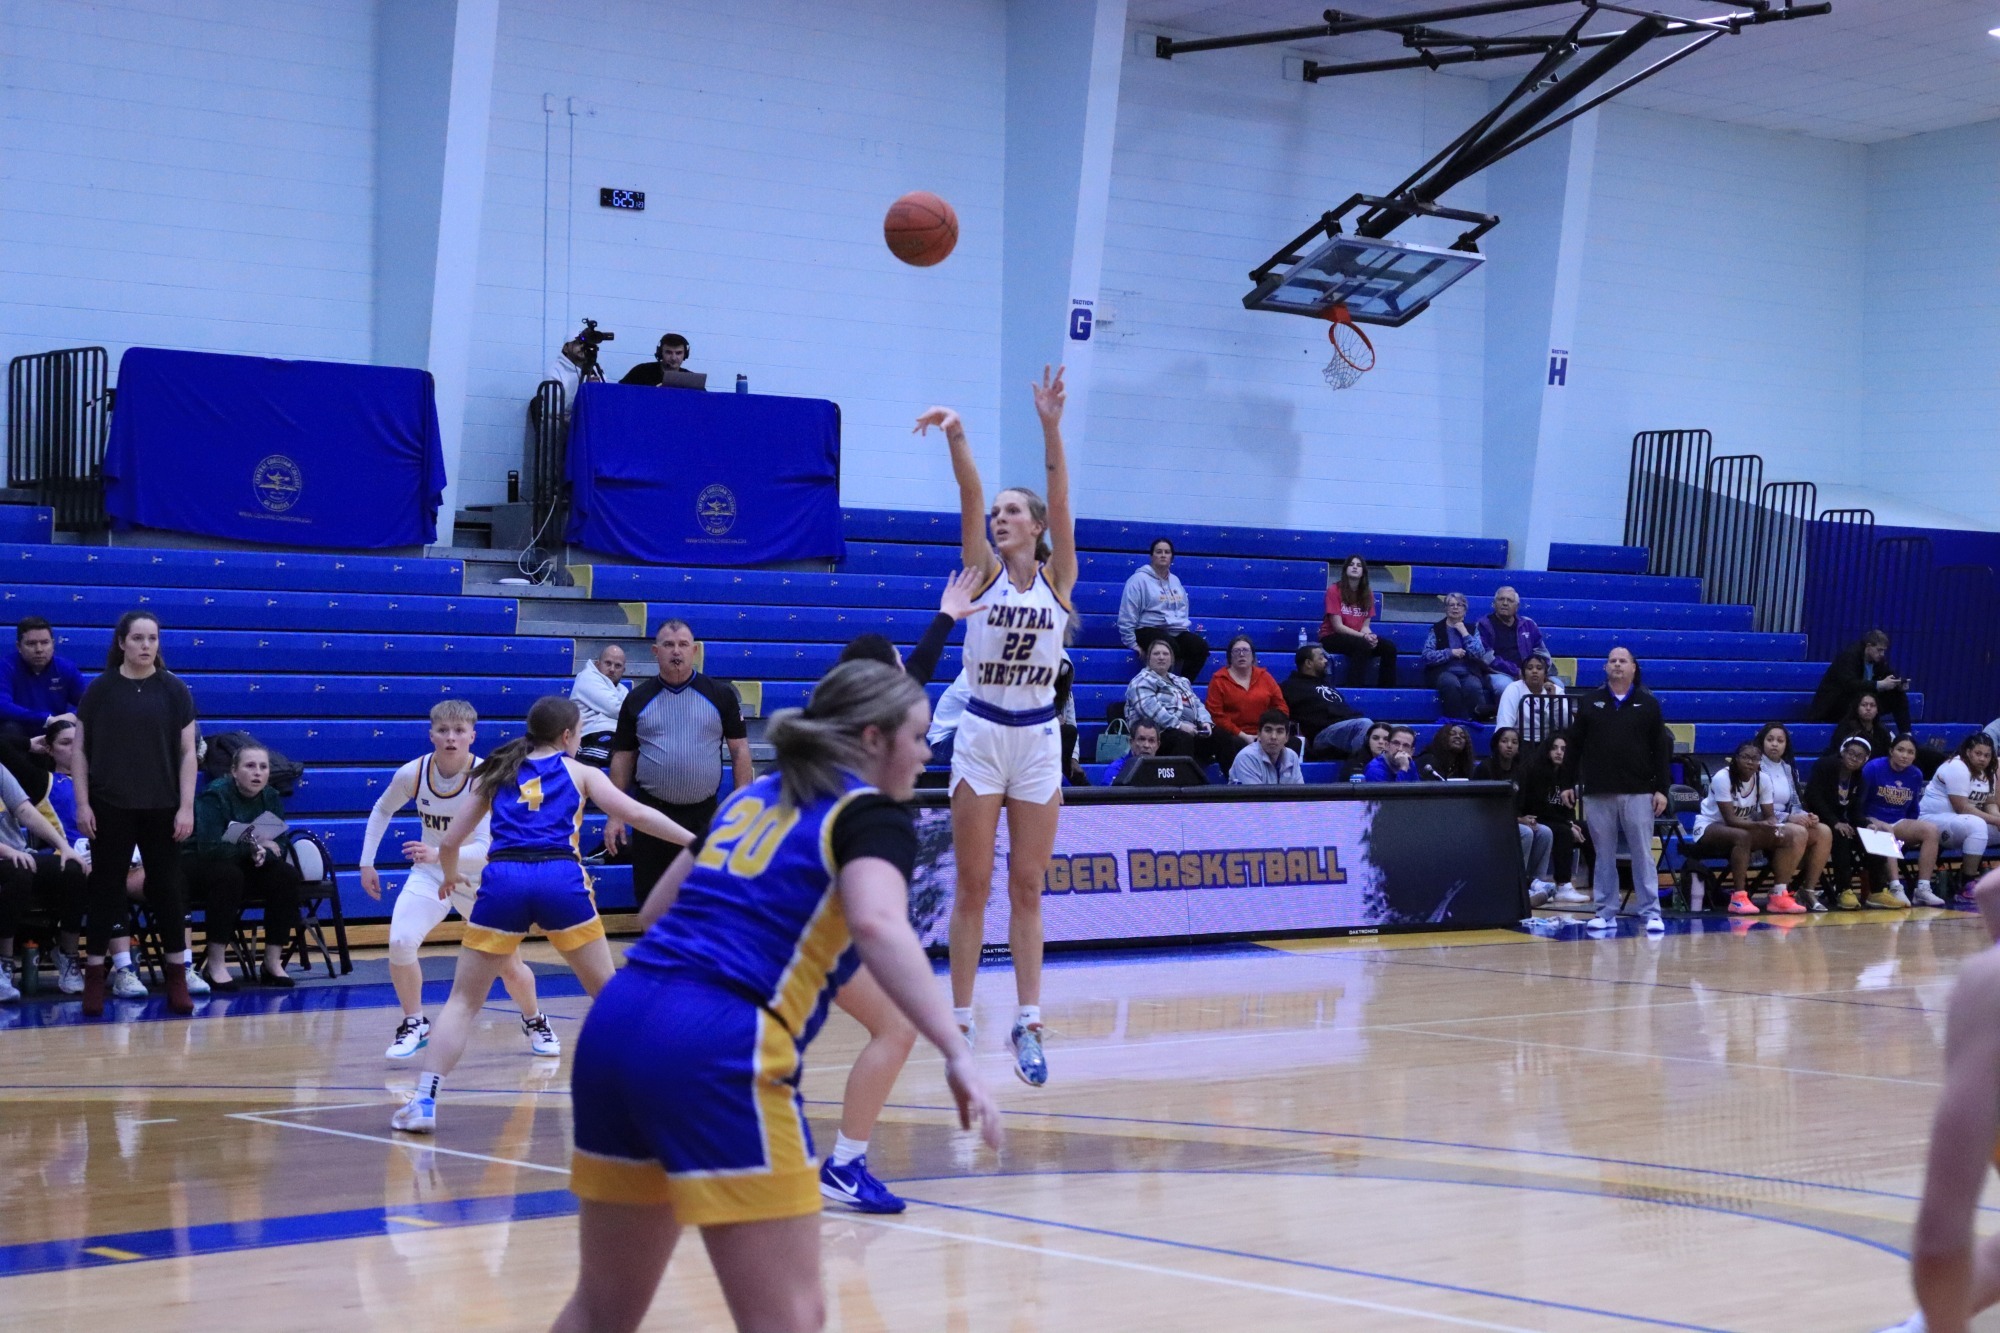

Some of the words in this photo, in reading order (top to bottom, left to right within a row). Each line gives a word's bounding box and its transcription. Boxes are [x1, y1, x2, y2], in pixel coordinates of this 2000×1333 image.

[613, 190, 634, 208] 6:25
[1070, 308, 1092, 341] G
[1548, 357, 1567, 386] H
[987, 604, 1054, 630] CENTRAL
[1001, 632, 1037, 661] 22
[1158, 768, 1175, 778] POSS
[516, 775, 544, 811] 4
[1670, 791, 1700, 801] TIGERS
[696, 796, 801, 879] 20
[1041, 852, 1121, 895] GER
[1127, 846, 1347, 892] BASKETBALL
